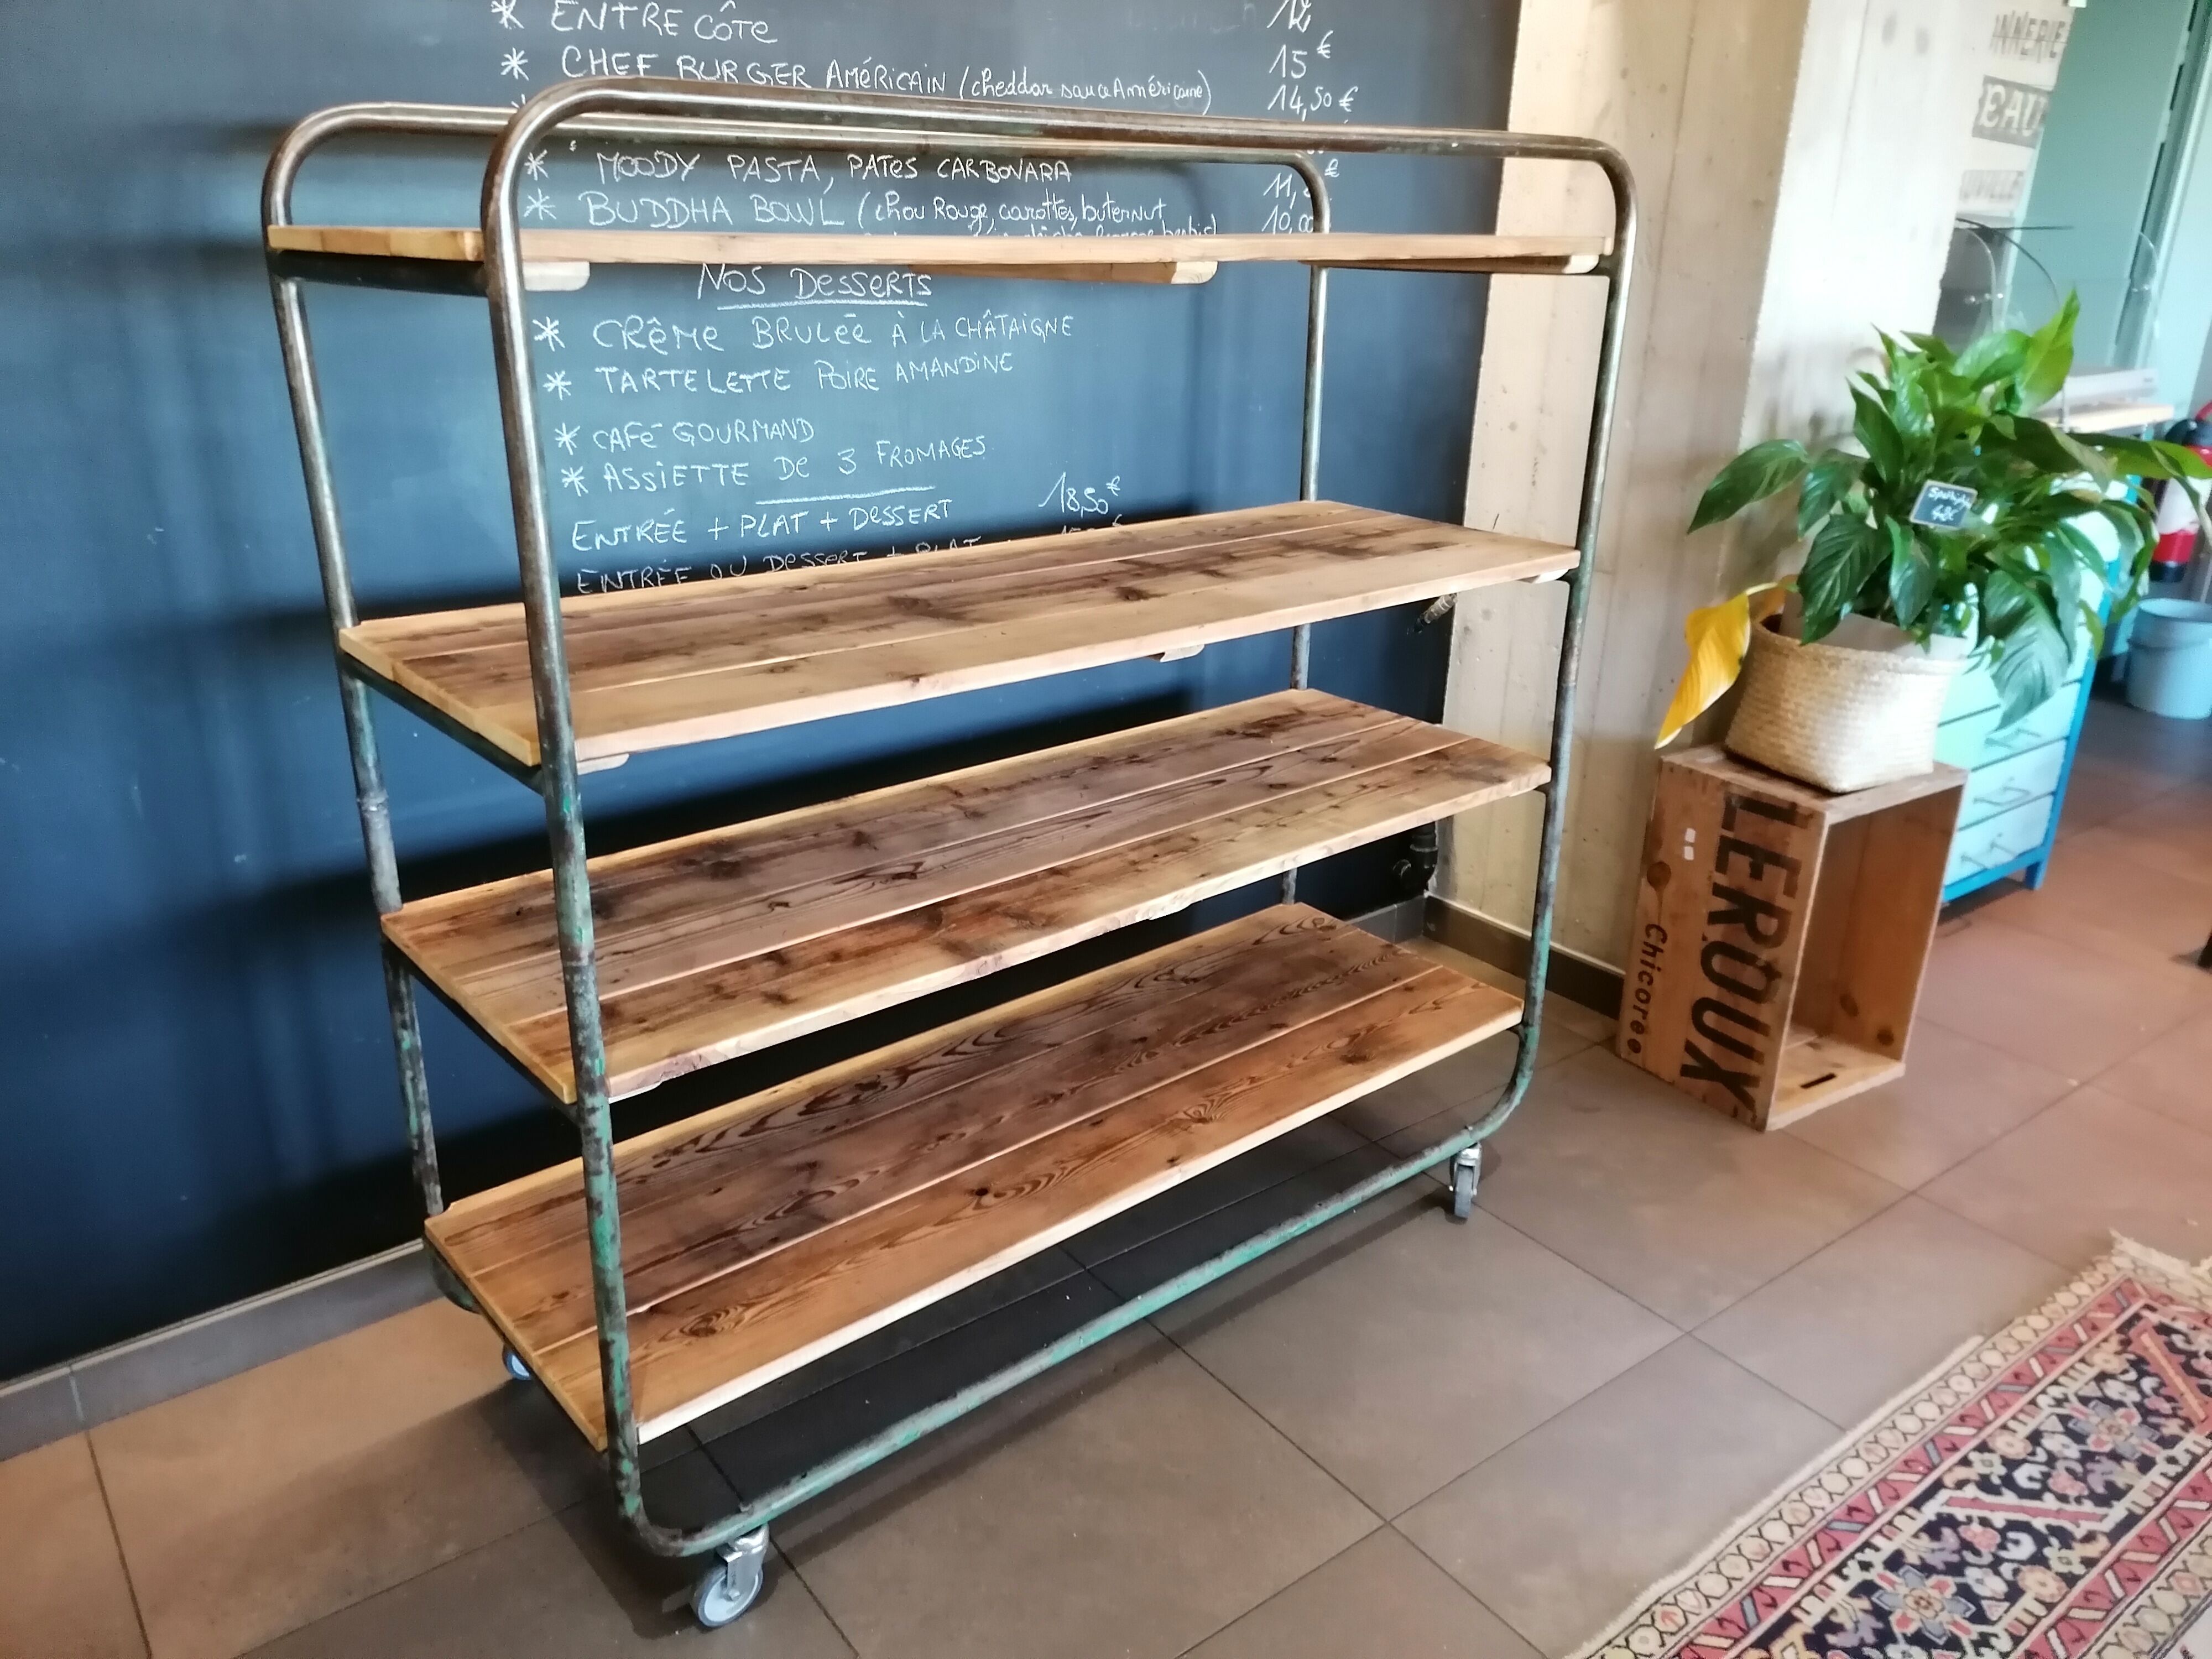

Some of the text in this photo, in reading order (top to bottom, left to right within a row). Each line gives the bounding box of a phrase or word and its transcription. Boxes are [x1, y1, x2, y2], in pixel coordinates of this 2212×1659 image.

[551, 0, 684, 36] ENTRE
[562, 45, 659, 78] CHEF
[1269, 30, 1334, 79] 15 €
[1267, 84, 1359, 122] 14,50 €
[597, 150, 701, 185] MOODY
[578, 190, 734, 229] BUDDHA
[749, 193, 845, 226] BOWL
[697, 263, 766, 299] NOS
[892, 310, 908, 348] À
[920, 319, 945, 343] LA
[594, 366, 791, 395] TARTELETTE
[671, 418, 815, 446] GOURMAND
[837, 448, 858, 475] 3
[875, 435, 985, 467] FROMAGES
[1038, 471, 1109, 519] 18,50
[571, 507, 688, 551] ENTRÉE
[740, 509, 809, 538] PLAT
[710, 554, 748, 580] OU
[1679, 791, 1813, 1124] LEROUX
